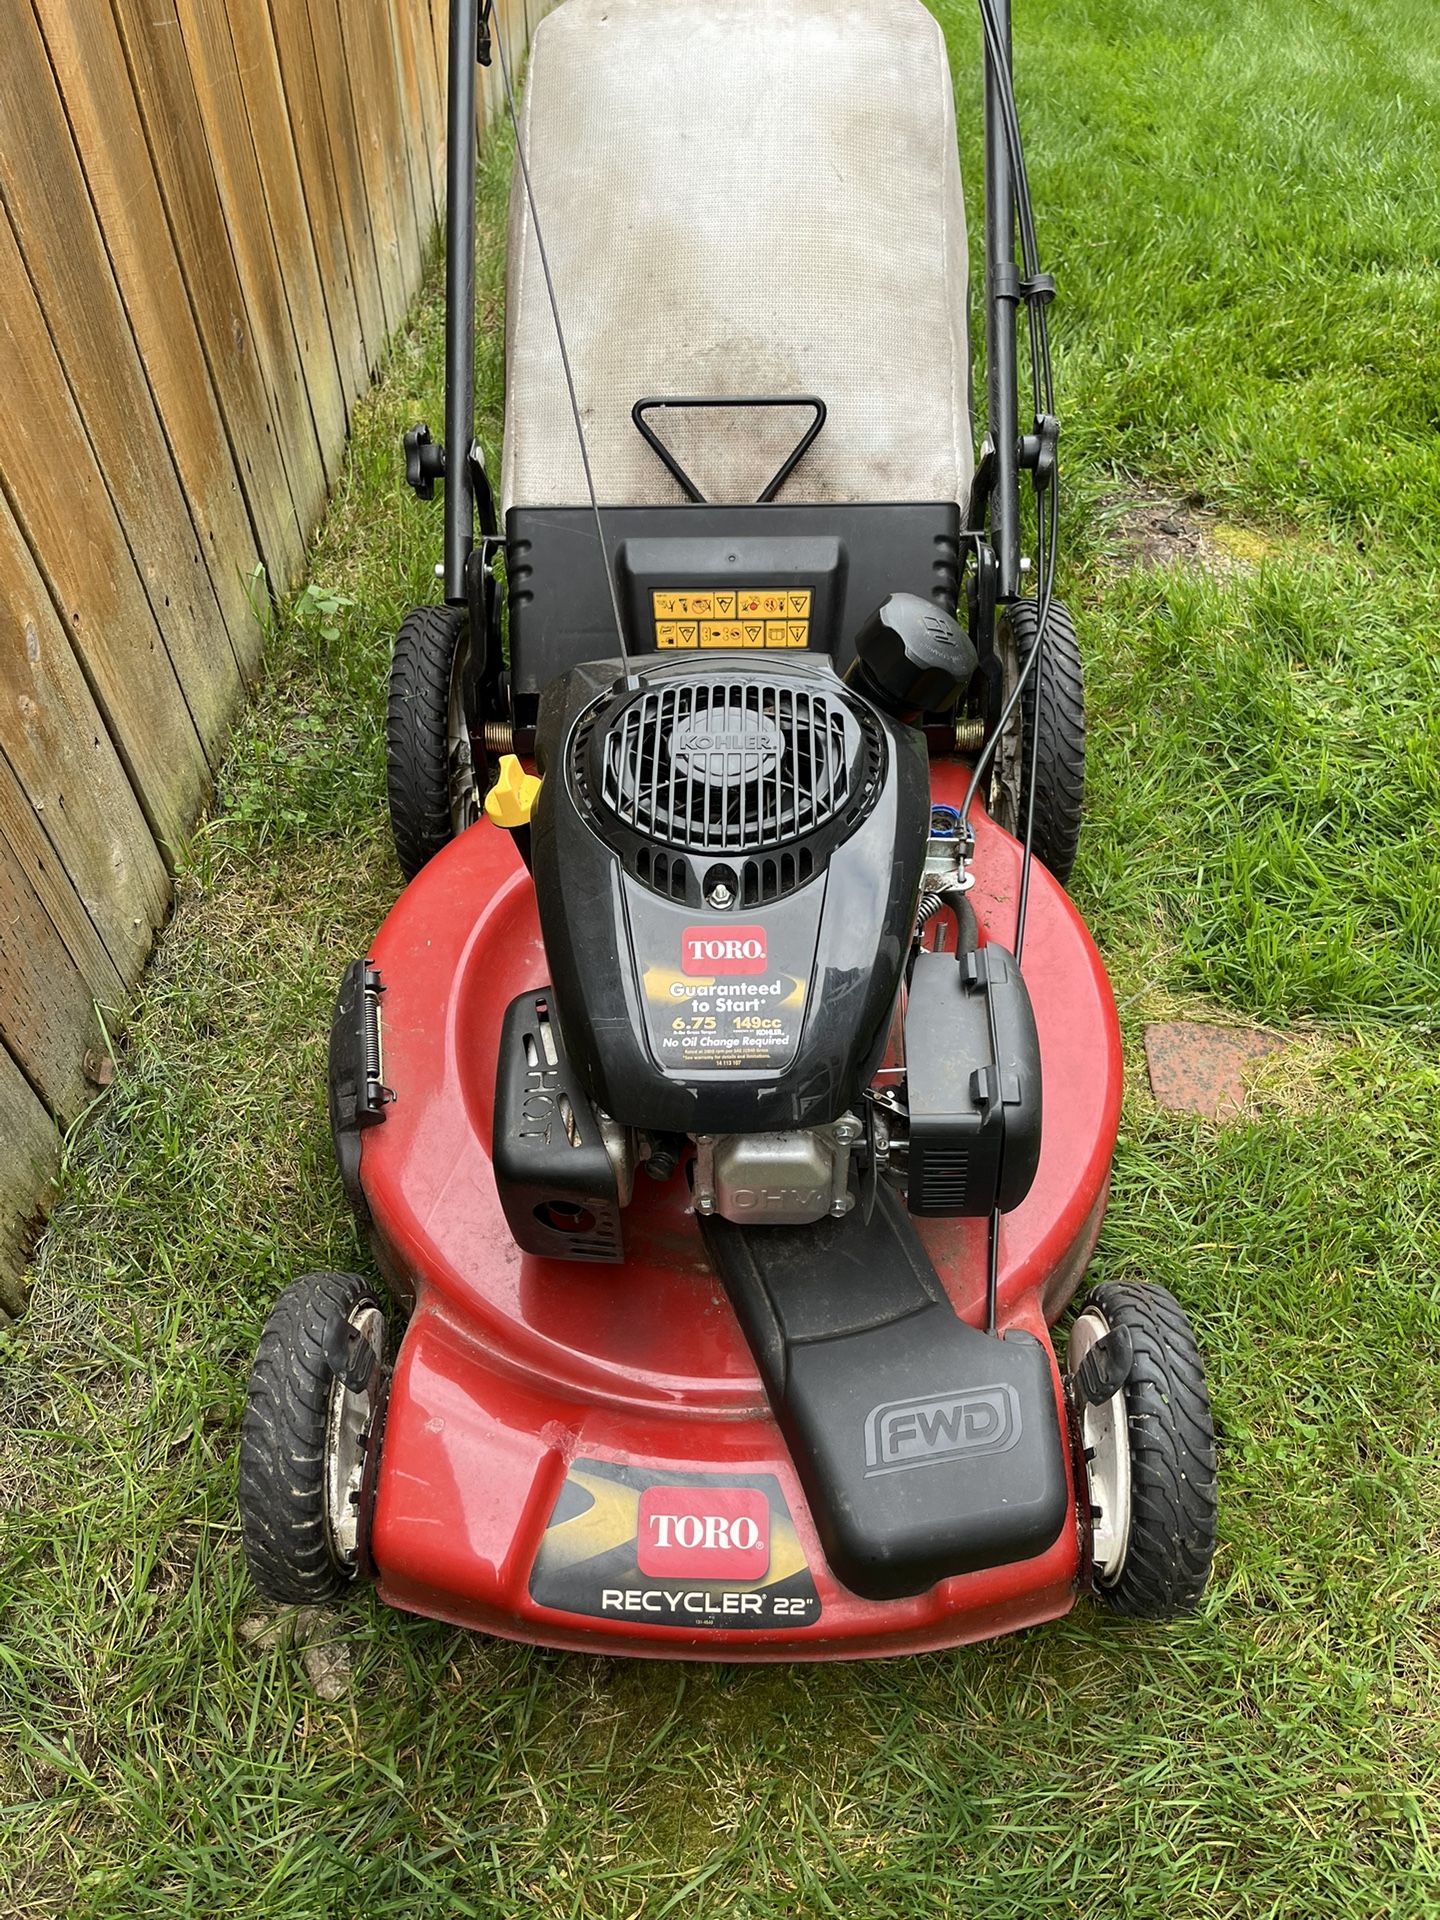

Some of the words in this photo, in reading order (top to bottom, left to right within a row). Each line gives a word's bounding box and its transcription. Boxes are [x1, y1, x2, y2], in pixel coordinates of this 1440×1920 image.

[680, 735, 772, 750] KOHLER
[688, 940, 763, 960] TORO
[669, 980, 781, 997] Guaranteed
[691, 999, 711, 1013] to
[672, 1016, 717, 1030] 6.75
[732, 1016, 782, 1029] 149cc
[662, 1037, 679, 1048] No
[682, 1036, 698, 1047] Oil
[699, 1036, 740, 1049] Change
[742, 1035, 790, 1048] Required
[519, 1070, 558, 1145] HOT
[731, 1188, 822, 1209] OHV
[889, 1402, 999, 1455] FWD
[650, 1515, 760, 1550] TORO
[602, 1589, 764, 1615] RECYCLER
[773, 1598, 814, 1615] 22"
